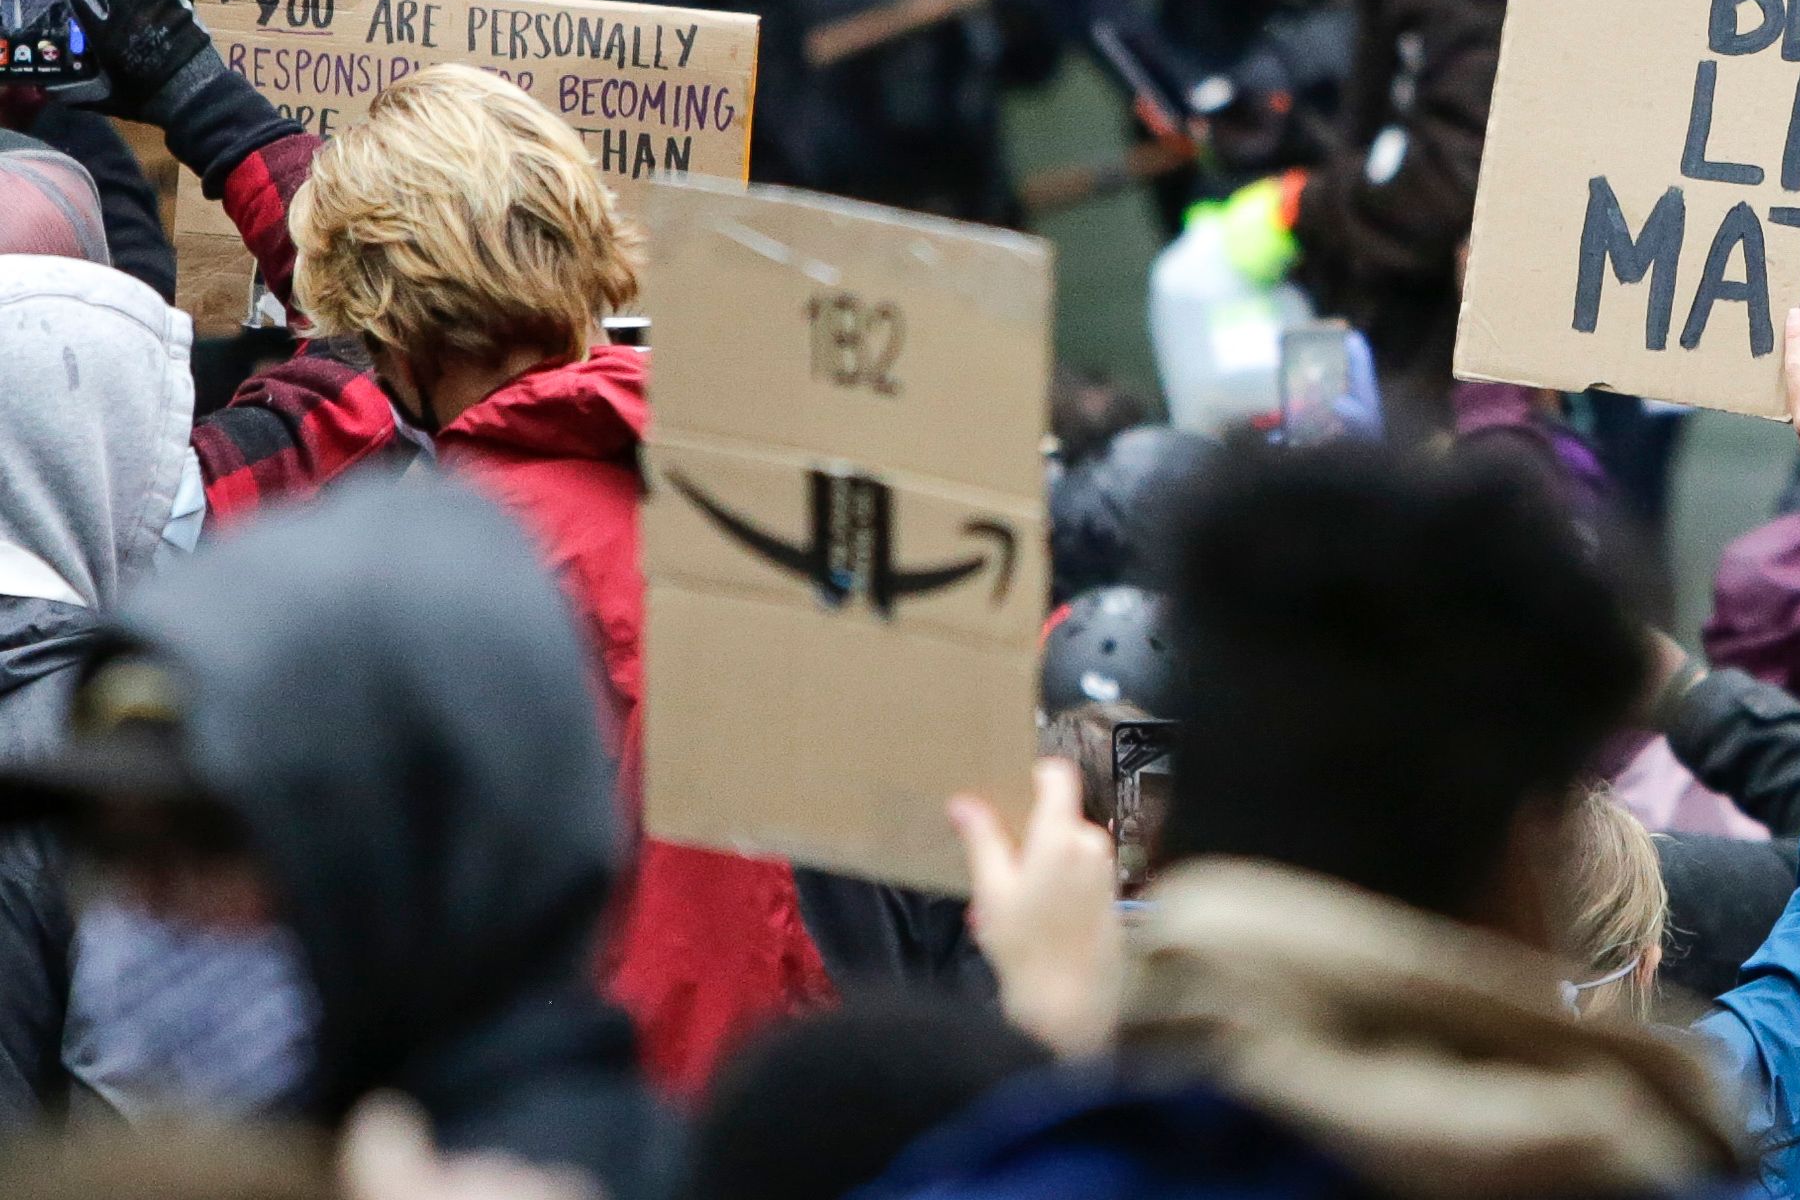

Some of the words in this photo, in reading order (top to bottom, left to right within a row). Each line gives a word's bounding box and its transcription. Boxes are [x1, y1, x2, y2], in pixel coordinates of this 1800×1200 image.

[467, 6, 697, 70] PERSONALLY
[229, 43, 440, 98] RESPONSIB
[559, 74, 735, 131] BECOMING
